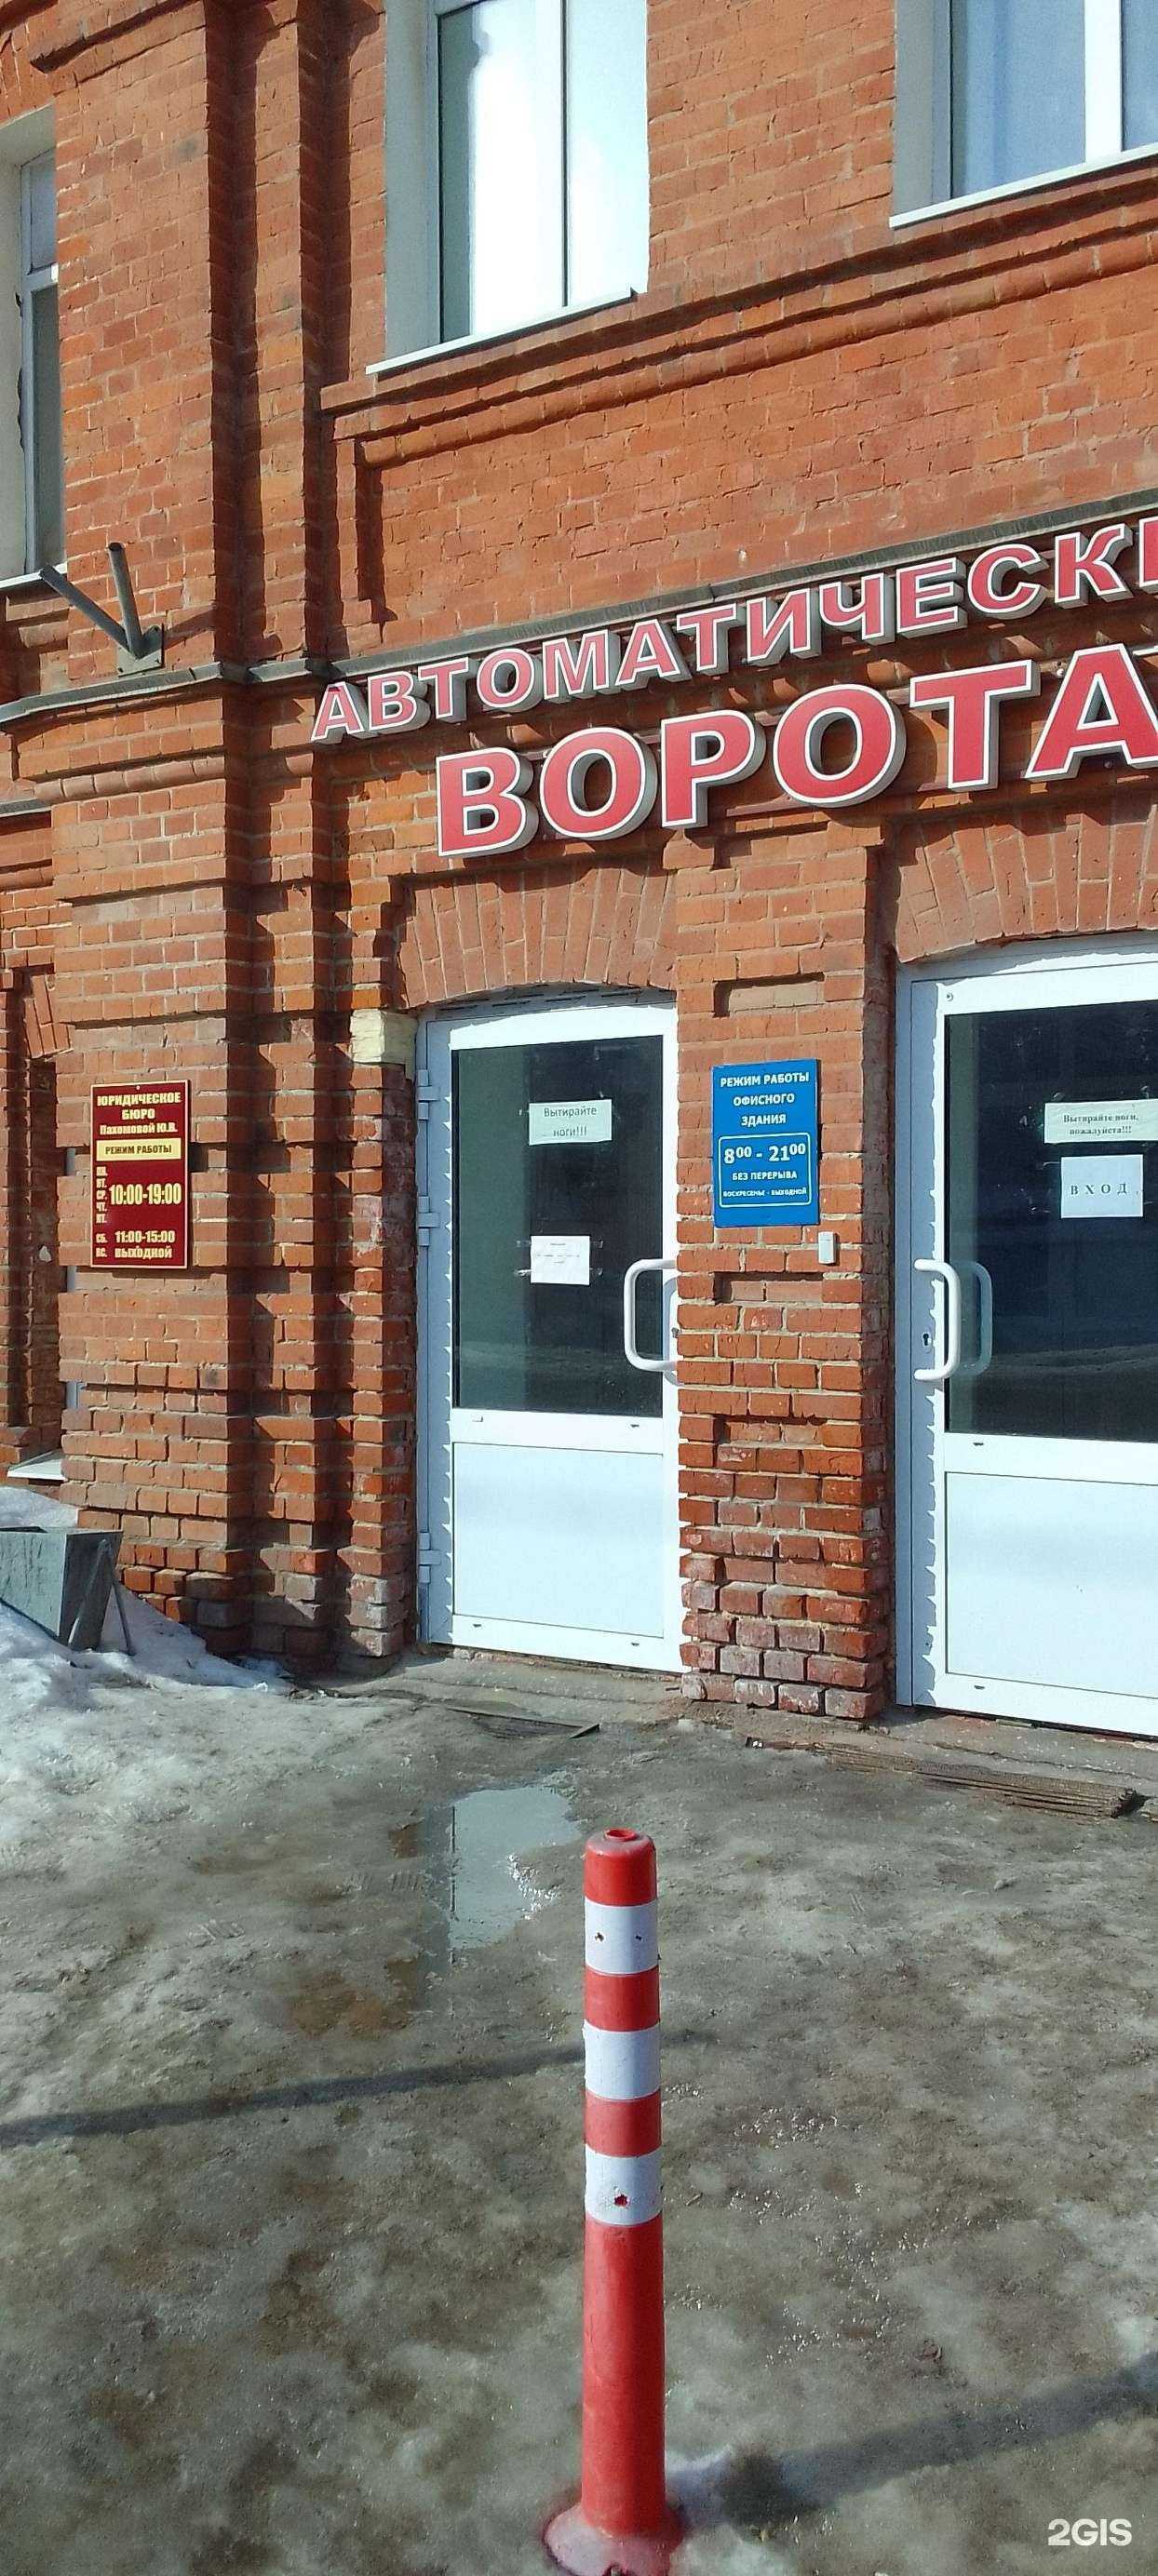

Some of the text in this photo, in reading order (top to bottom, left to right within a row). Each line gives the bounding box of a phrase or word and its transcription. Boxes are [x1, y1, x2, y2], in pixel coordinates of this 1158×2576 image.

[311, 517, 1158, 743] АВТОМАТИЧЕСК
[436, 642, 1158, 857] ВОРОТА
[720, 1072, 809, 1087] РЕЖИМ РАБОТЫ
[97, 1092, 182, 1107] ЮРИДИЧЕСКОЕ
[734, 1093, 795, 1106] ОФИСНОГО
[122, 1108, 155, 1120] БЮРО
[544, 1106, 598, 1118] Вытирайте
[1063, 1113, 1112, 1124] Вытирайте
[741, 1114, 787, 1127] ЗДАНИЯ
[100, 1121, 178, 1135] Пахомовой Ю.В.
[553, 1126, 587, 1137] ноги!!!
[1070, 1125, 1132, 1136] пожалуйста!!!
[105, 1145, 172, 1155] РЕЖИМ РАБОТЫ
[733, 1170, 798, 1181] БЕЗ ПЕРЕРЫВА
[109, 1183, 182, 1204] 10:00-19:00
[723, 1189, 765, 1198] ВОСКРЕСЕНЬЕ
[771, 1187, 807, 1197] ВЫХОДНОЙ
[114, 1230, 176, 1243] 11:00-15:00
[114, 1245, 173, 1259] ВЫХОДНОЙ
